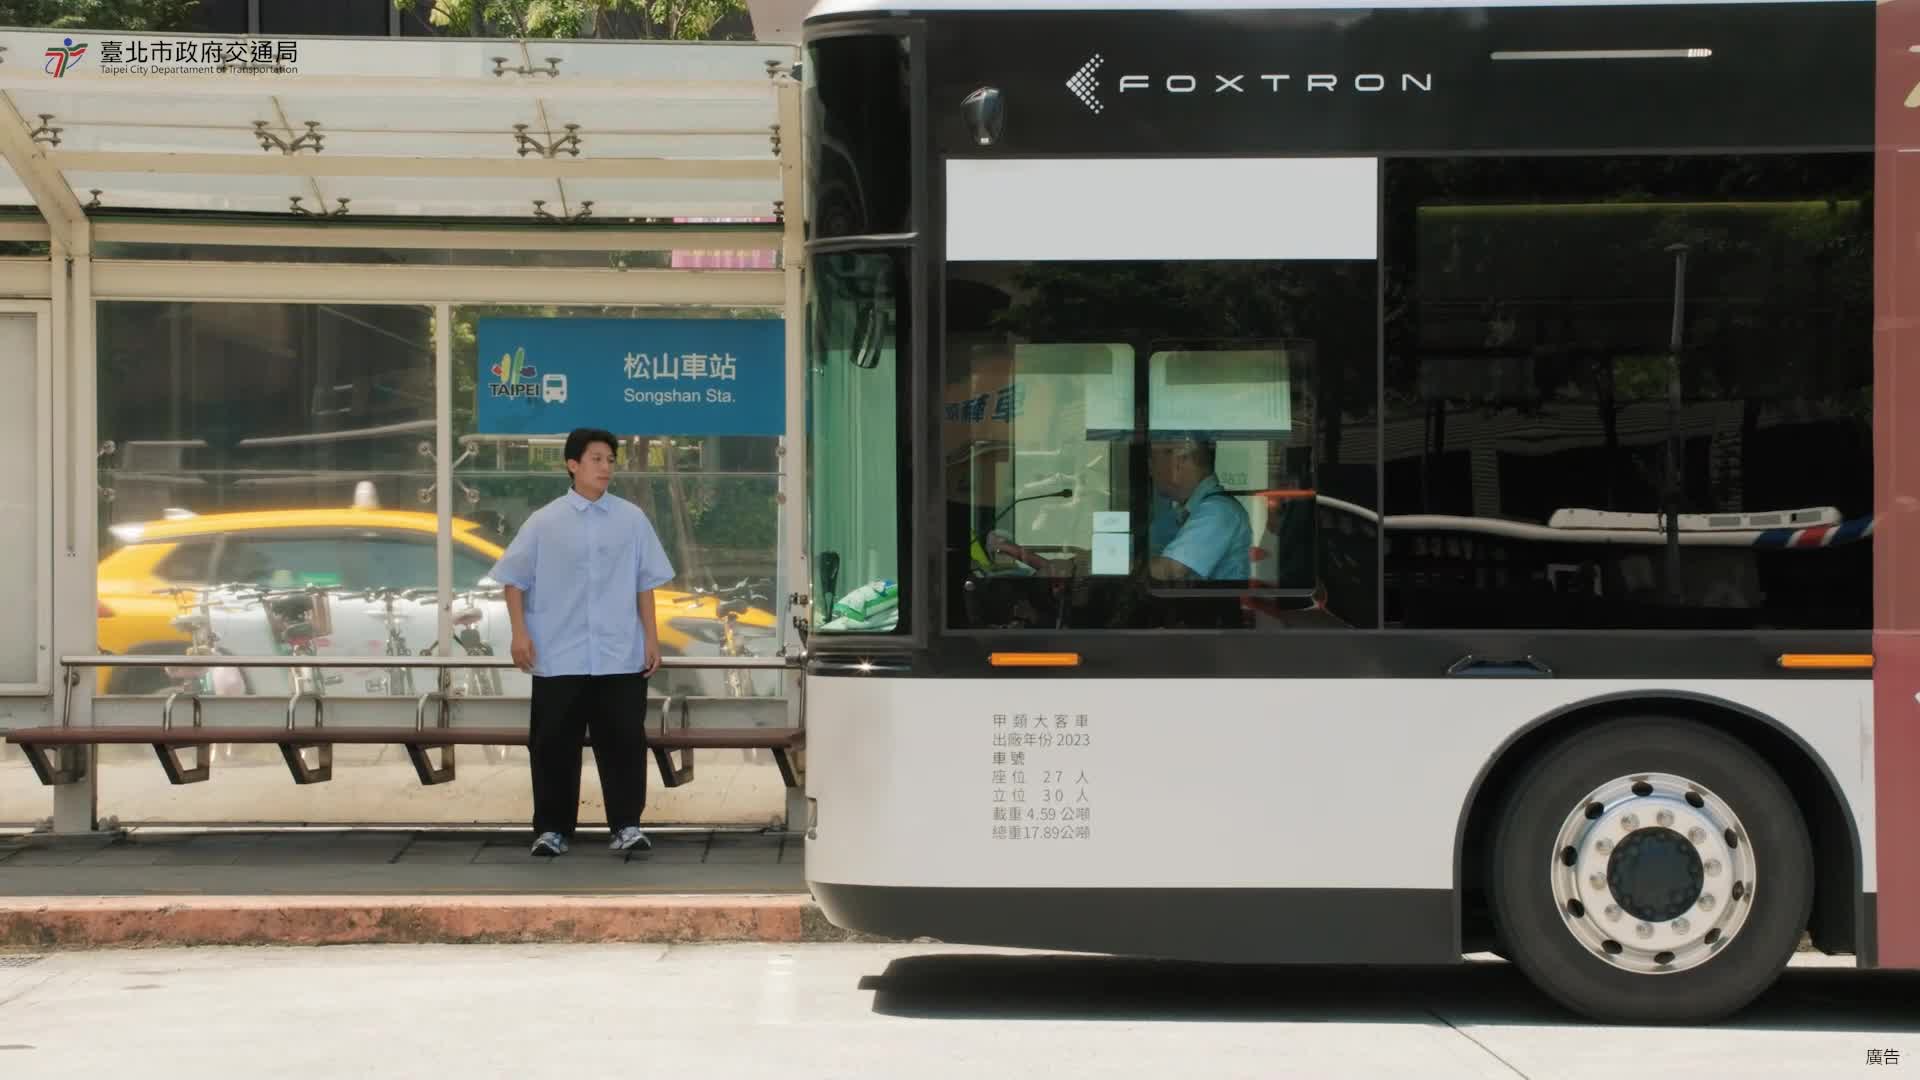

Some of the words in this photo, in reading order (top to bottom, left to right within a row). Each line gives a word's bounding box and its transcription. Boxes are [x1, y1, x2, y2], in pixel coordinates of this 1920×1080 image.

[1119, 73, 1432, 92] FOXTRON
[624, 351, 737, 381] 松山車站
[489, 383, 540, 396] TAIPEI
[624, 387, 701, 406] Songshan
[705, 387, 736, 403] Sta.
[993, 713, 1089, 729] 甲類大客車
[1056, 733, 1090, 746] 2023
[1075, 769, 1089, 784] 人
[1075, 788, 1089, 802] 人
